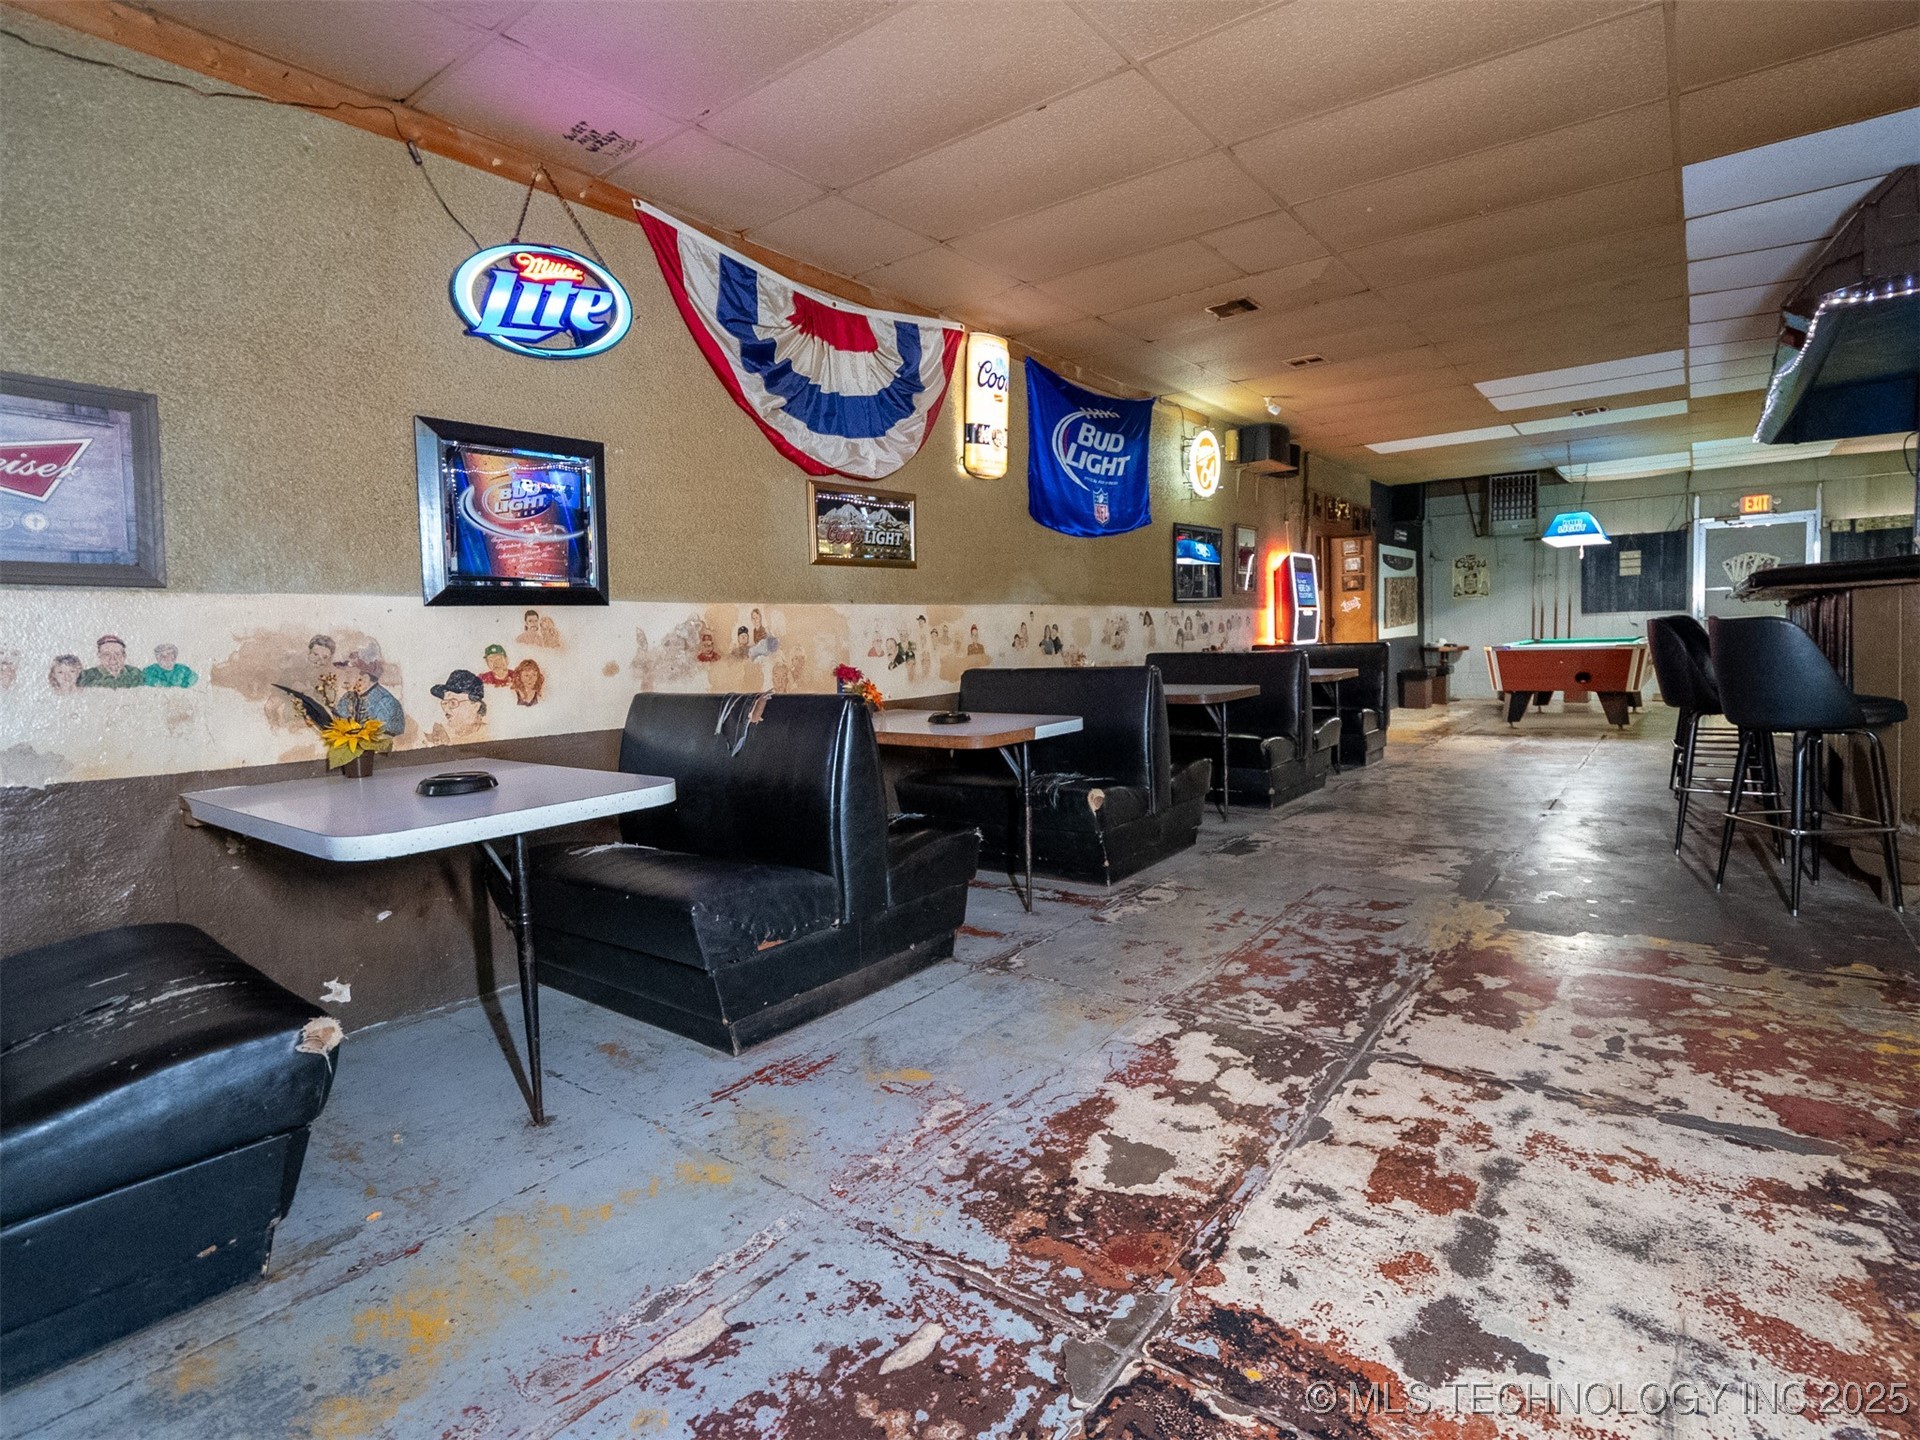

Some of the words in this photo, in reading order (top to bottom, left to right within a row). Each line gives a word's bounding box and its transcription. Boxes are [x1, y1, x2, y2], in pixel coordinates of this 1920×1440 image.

[514, 253, 584, 281] Miller
[474, 269, 613, 343] Lite
[1077, 422, 1125, 452] BUD
[1065, 443, 1131, 476] LIGHT
[494, 494, 547, 514] LIGHT
[1744, 495, 1769, 513] EXIT
[863, 530, 903, 546] LIGHT
